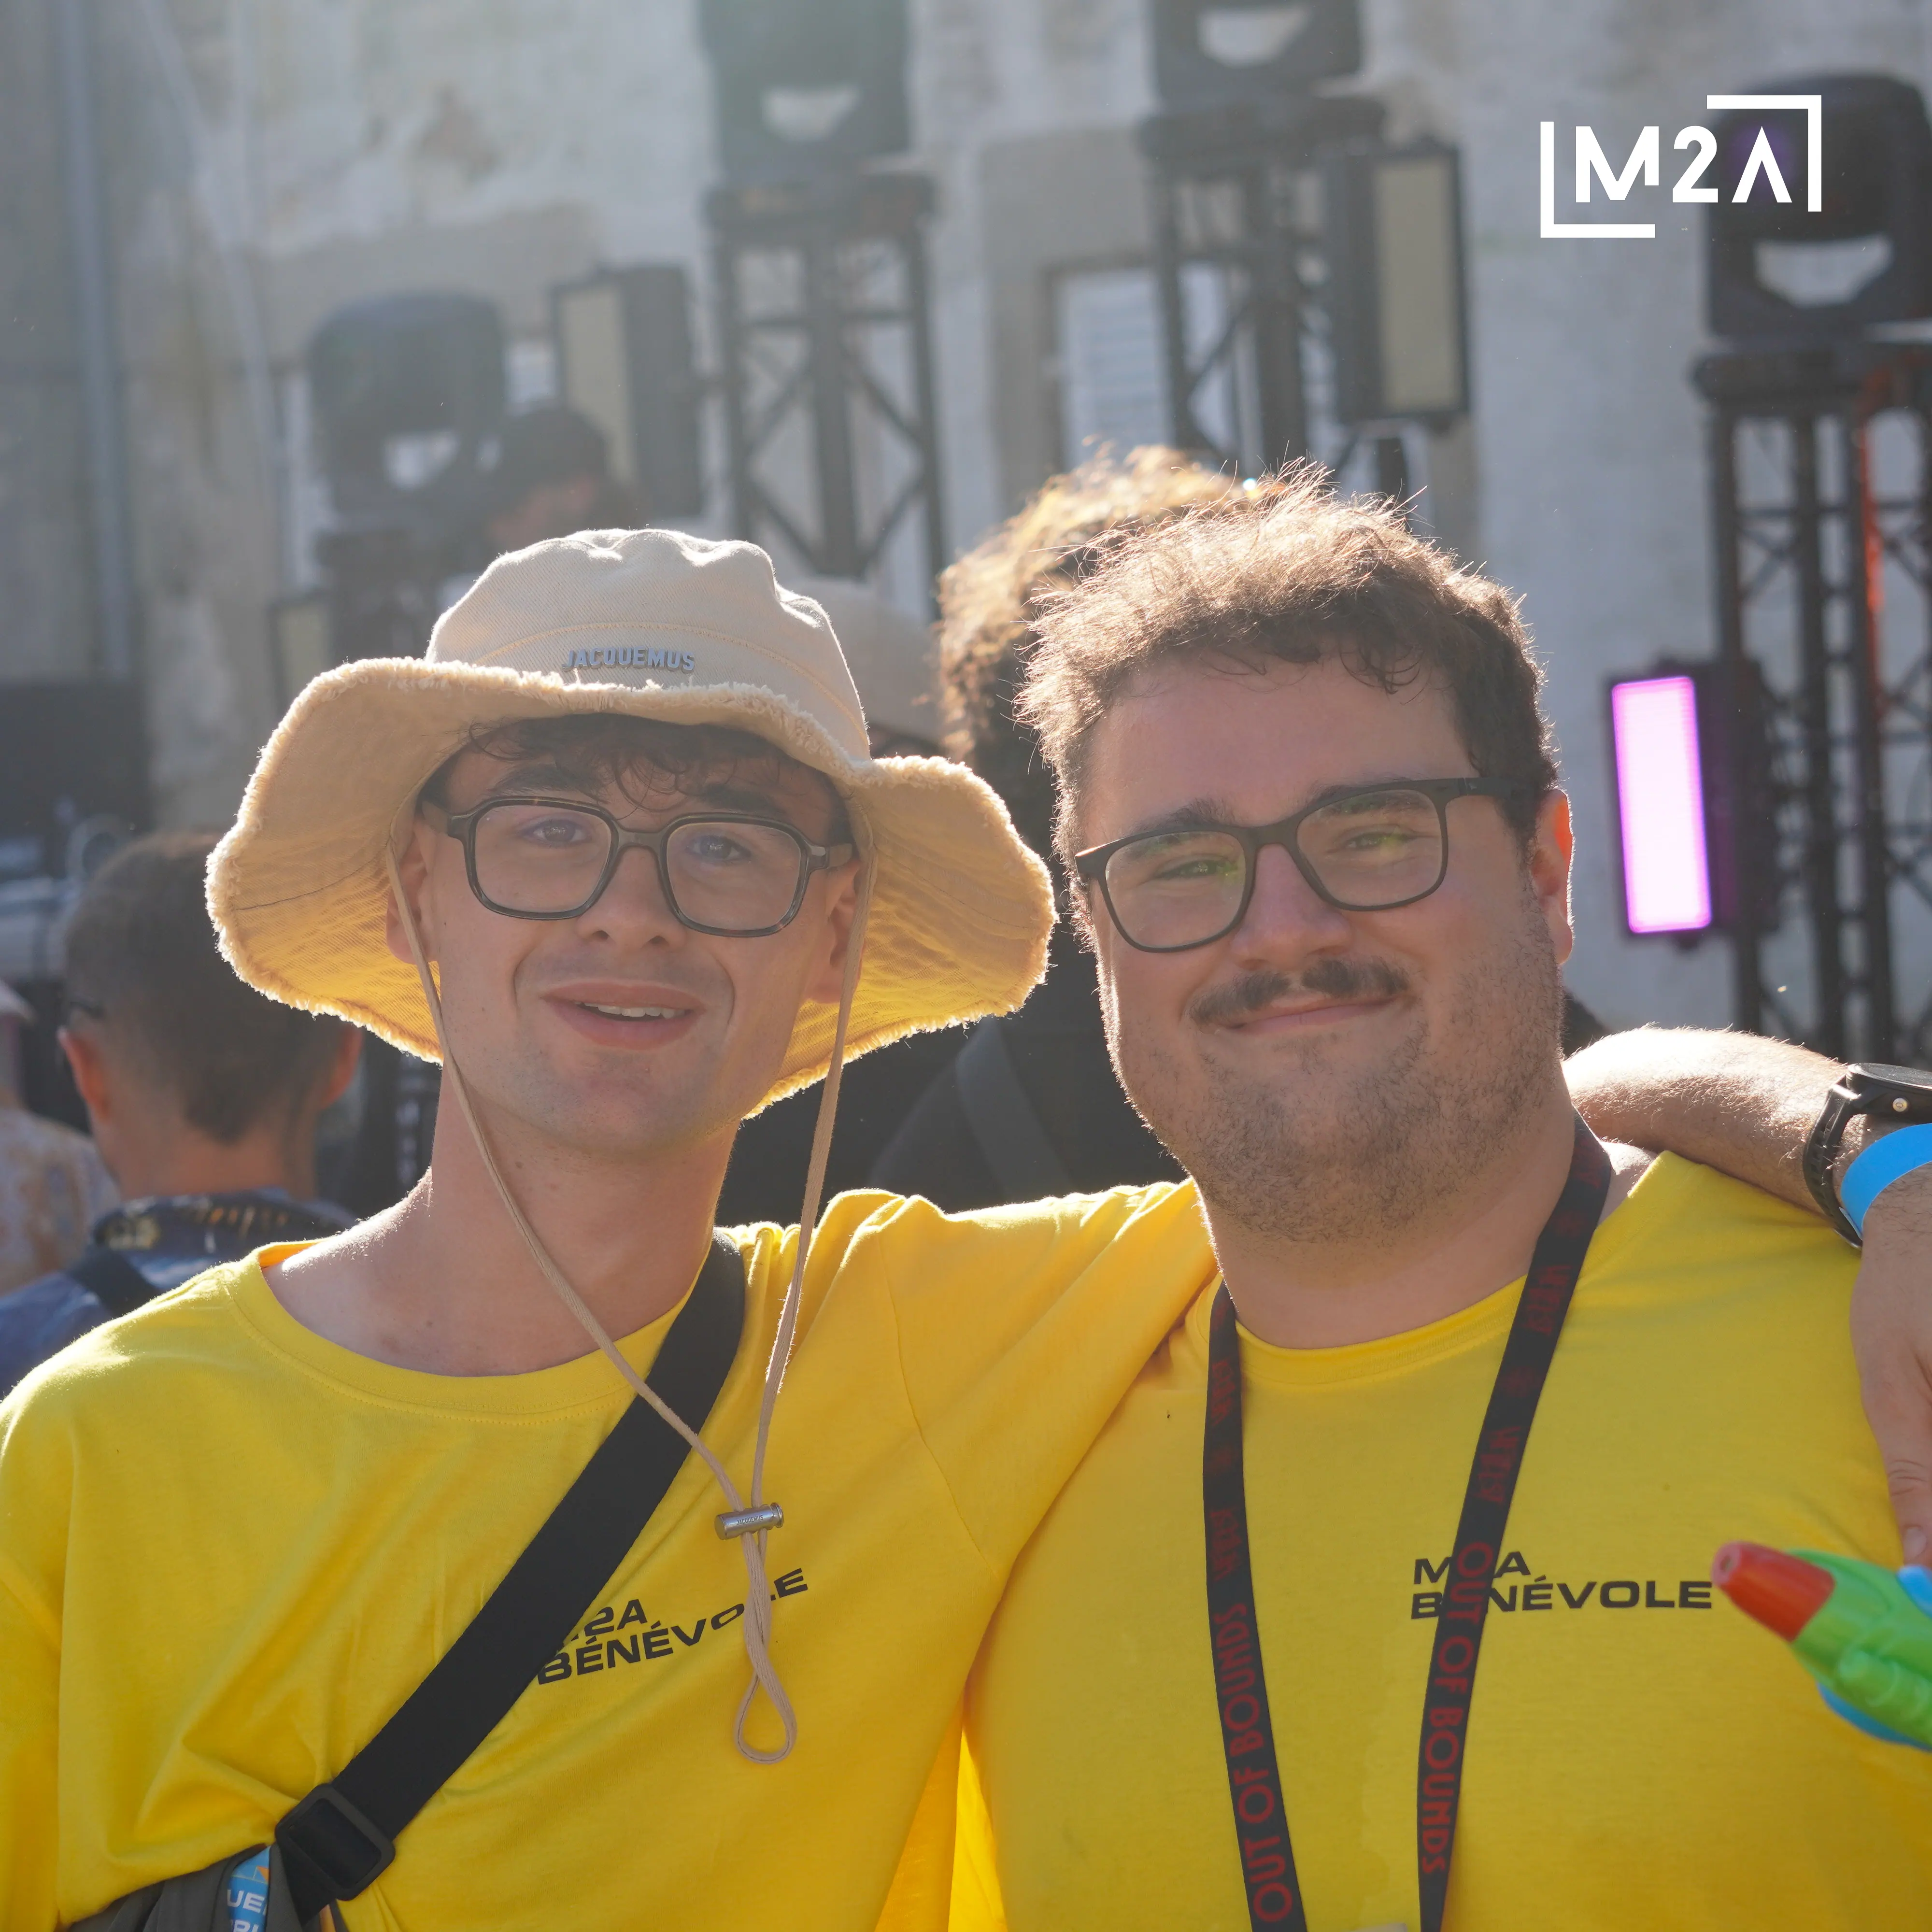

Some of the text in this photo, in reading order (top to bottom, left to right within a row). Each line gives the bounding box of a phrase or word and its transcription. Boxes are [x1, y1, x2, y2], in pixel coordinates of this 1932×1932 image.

[562, 646, 695, 672] JACQUEMUS
[737, 1515, 764, 1525] JACQUEMUS
[1414, 1551, 1531, 1584] MA
[571, 1599, 647, 1641] 2A
[1411, 1575, 1712, 1619] BNÉVOLE
[538, 1568, 808, 1685] BÉNÉVOE
[1213, 1603, 1264, 1757] BOUNDS
[1422, 1542, 1493, 1875] OUT OF BOUNDS
[1233, 1768, 1275, 1824] OF
[1244, 1835, 1293, 1923] OUT
